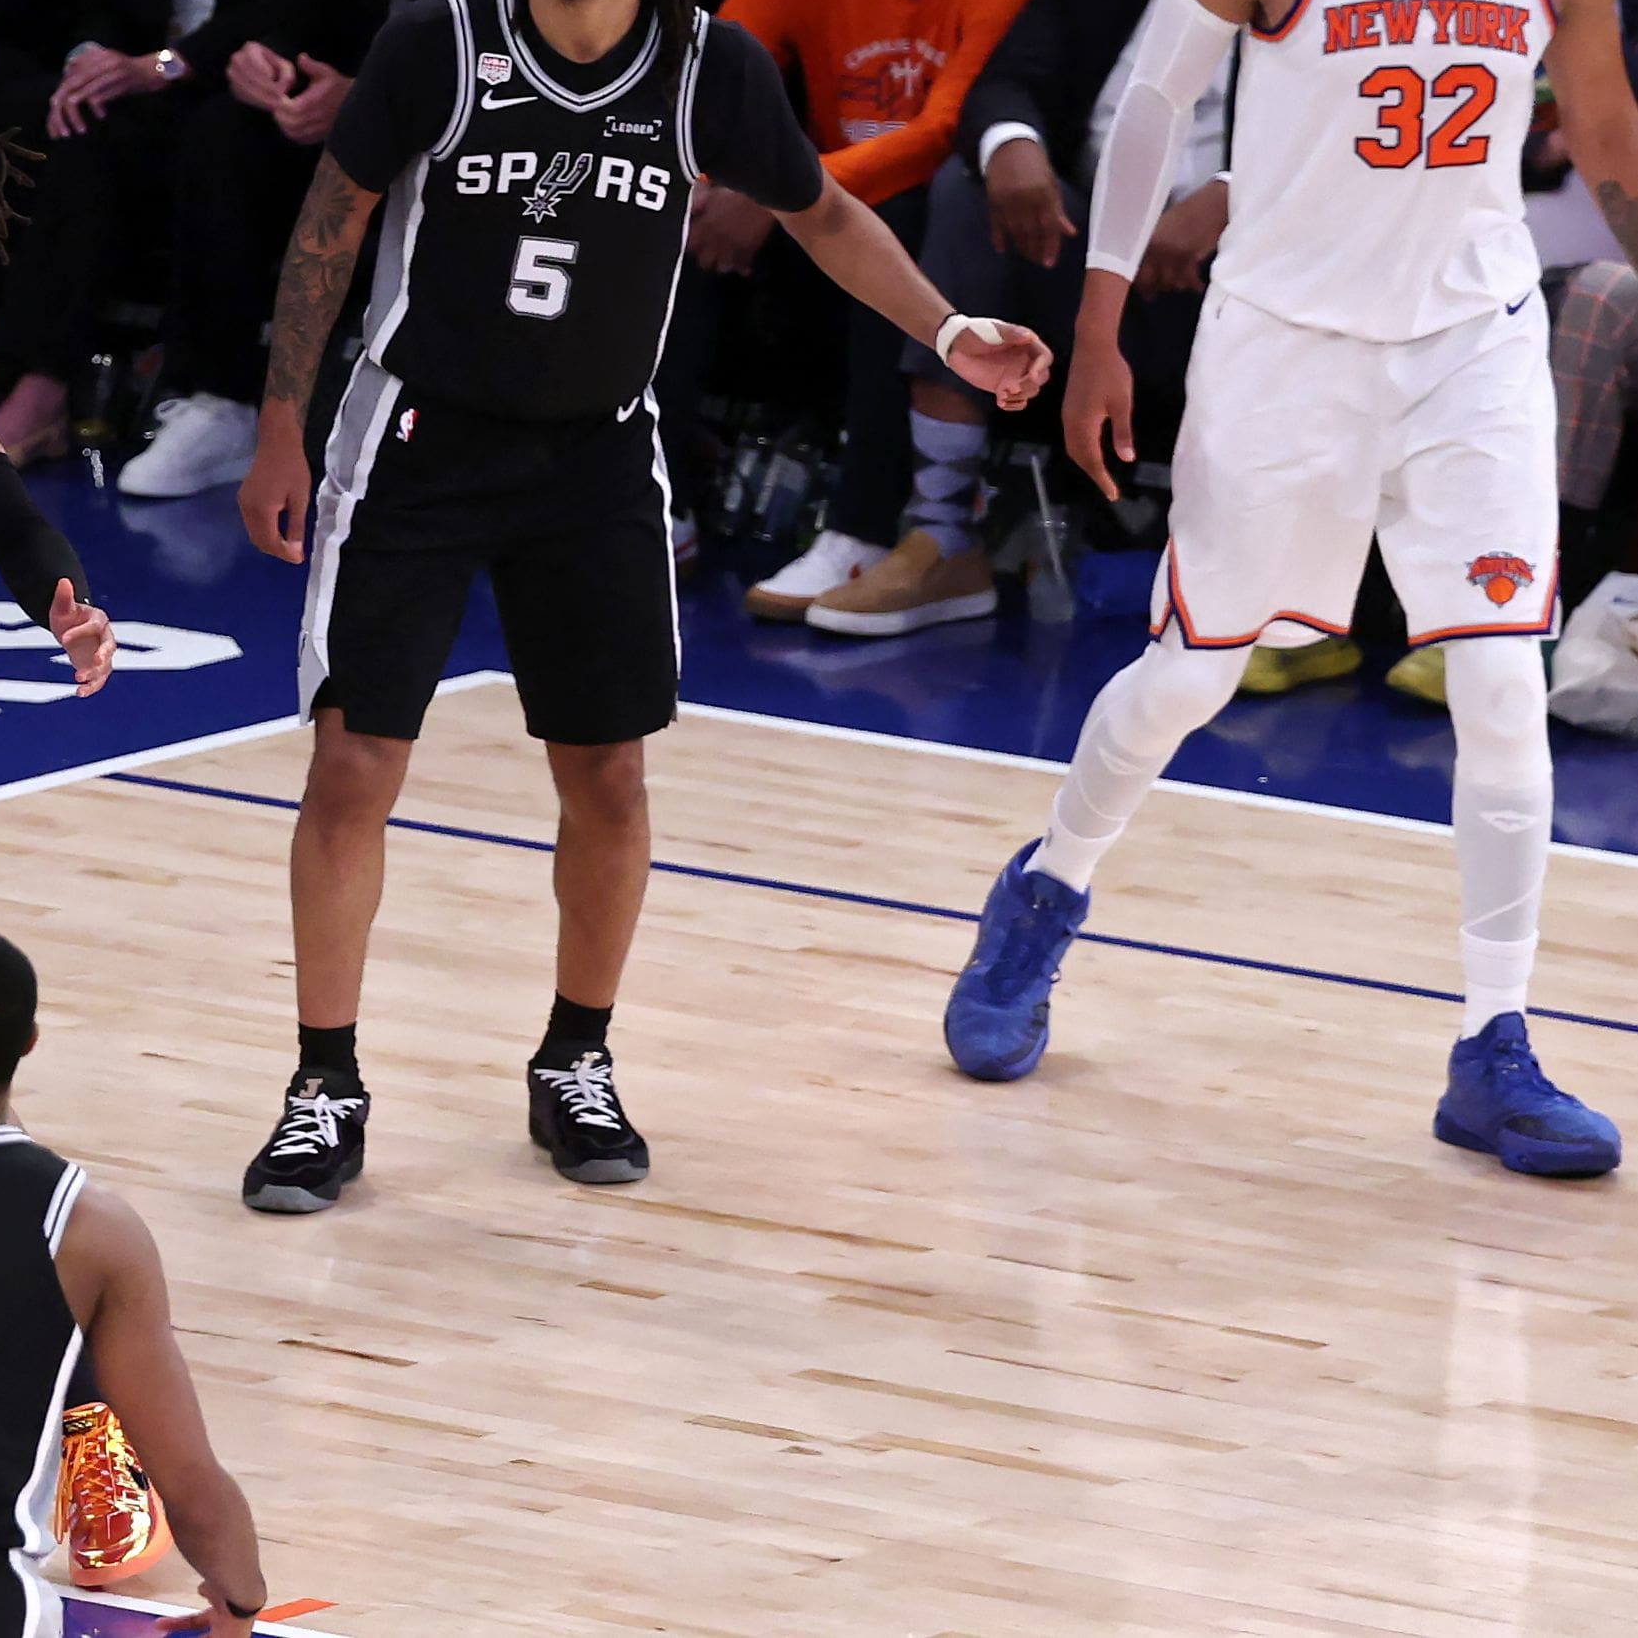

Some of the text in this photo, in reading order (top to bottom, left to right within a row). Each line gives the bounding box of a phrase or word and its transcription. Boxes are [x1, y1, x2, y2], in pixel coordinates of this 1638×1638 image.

[610, 121, 654, 135] LEDGER
[1354, 64, 1498, 170] 32
[456, 151, 671, 223] SPURS
[506, 235, 580, 321] 5
